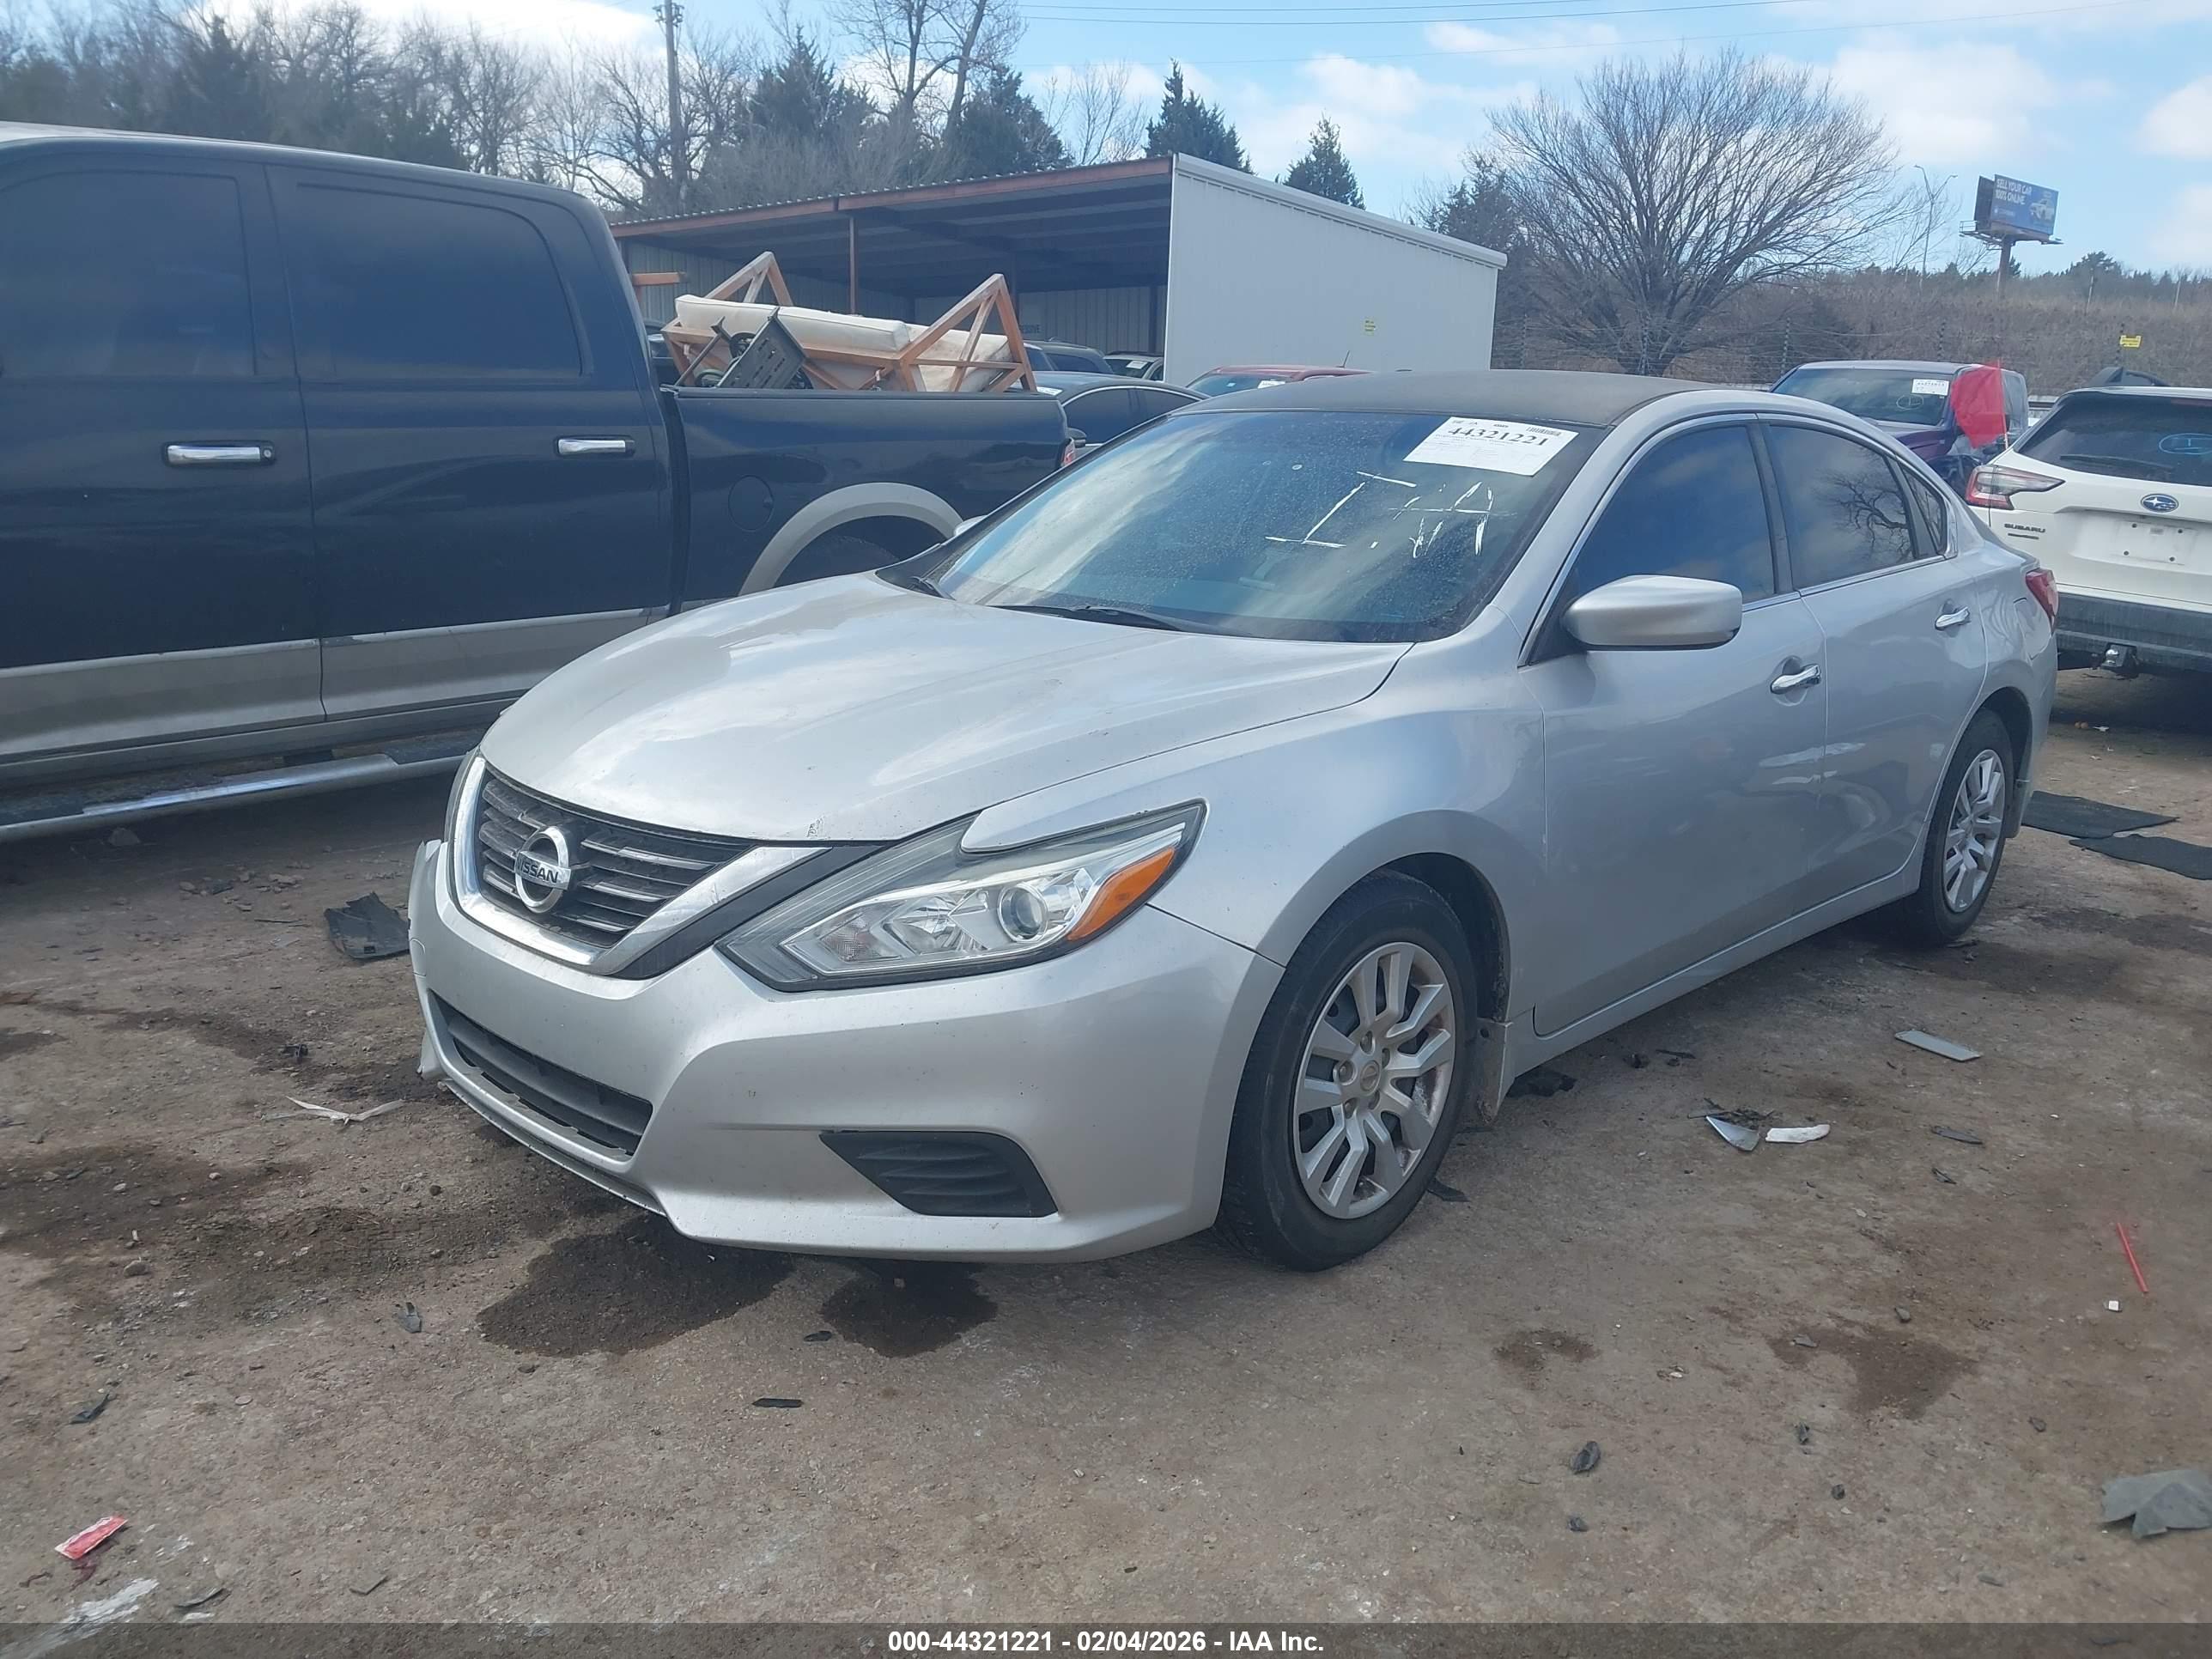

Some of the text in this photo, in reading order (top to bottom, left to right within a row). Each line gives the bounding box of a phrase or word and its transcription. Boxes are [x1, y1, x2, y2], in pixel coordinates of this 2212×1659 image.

[1997, 179, 2033, 196] SELL YOUR CAR
[2007, 191, 2026, 204] ONLINE
[1448, 426, 1549, 447] 44321221
[2004, 523, 2045, 533] SUBARU
[515, 856, 559, 884] NISSAN
